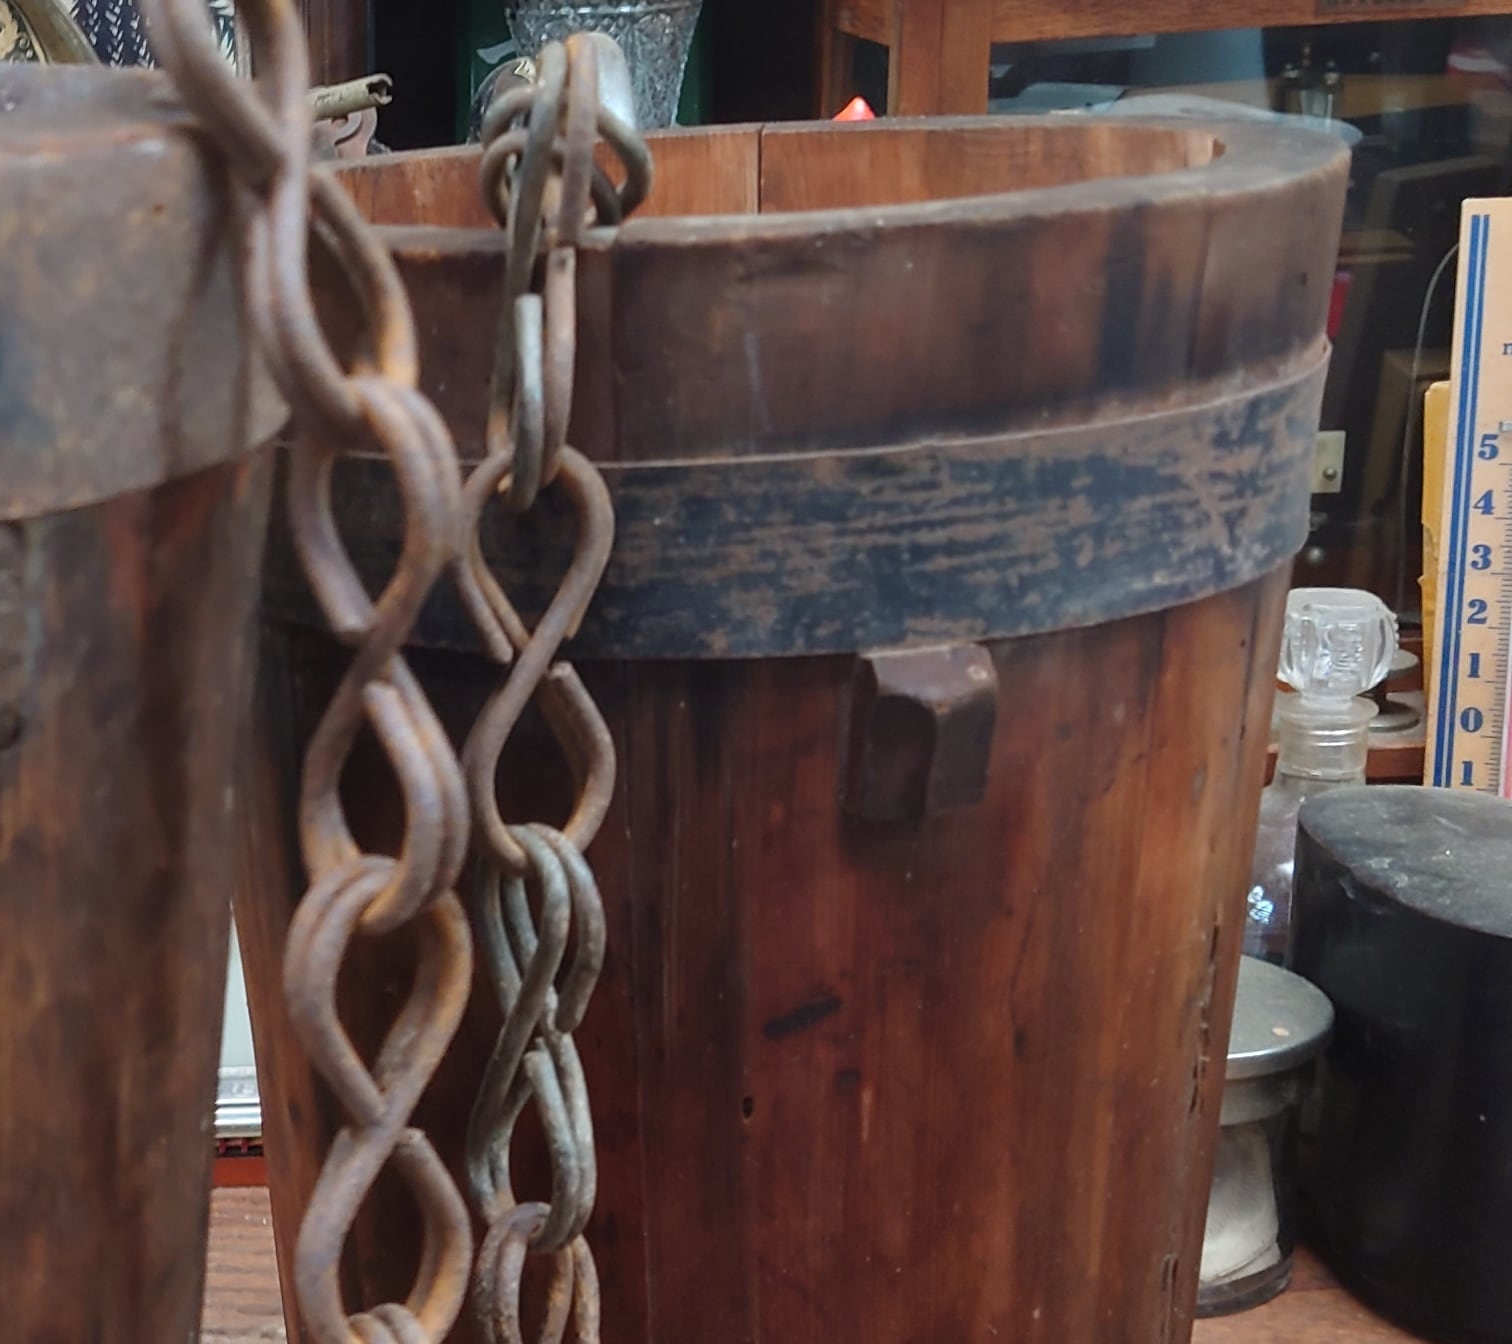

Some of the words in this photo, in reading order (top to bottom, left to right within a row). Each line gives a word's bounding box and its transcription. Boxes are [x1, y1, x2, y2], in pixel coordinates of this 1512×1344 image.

[1478, 434, 1499, 460] 5
[1473, 489, 1495, 515] 4
[1471, 544, 1492, 570] 3
[1467, 599, 1488, 624] 2
[1467, 653, 1480, 678] 1
[1460, 707, 1483, 733] 0
[1460, 761, 1474, 786] 1
